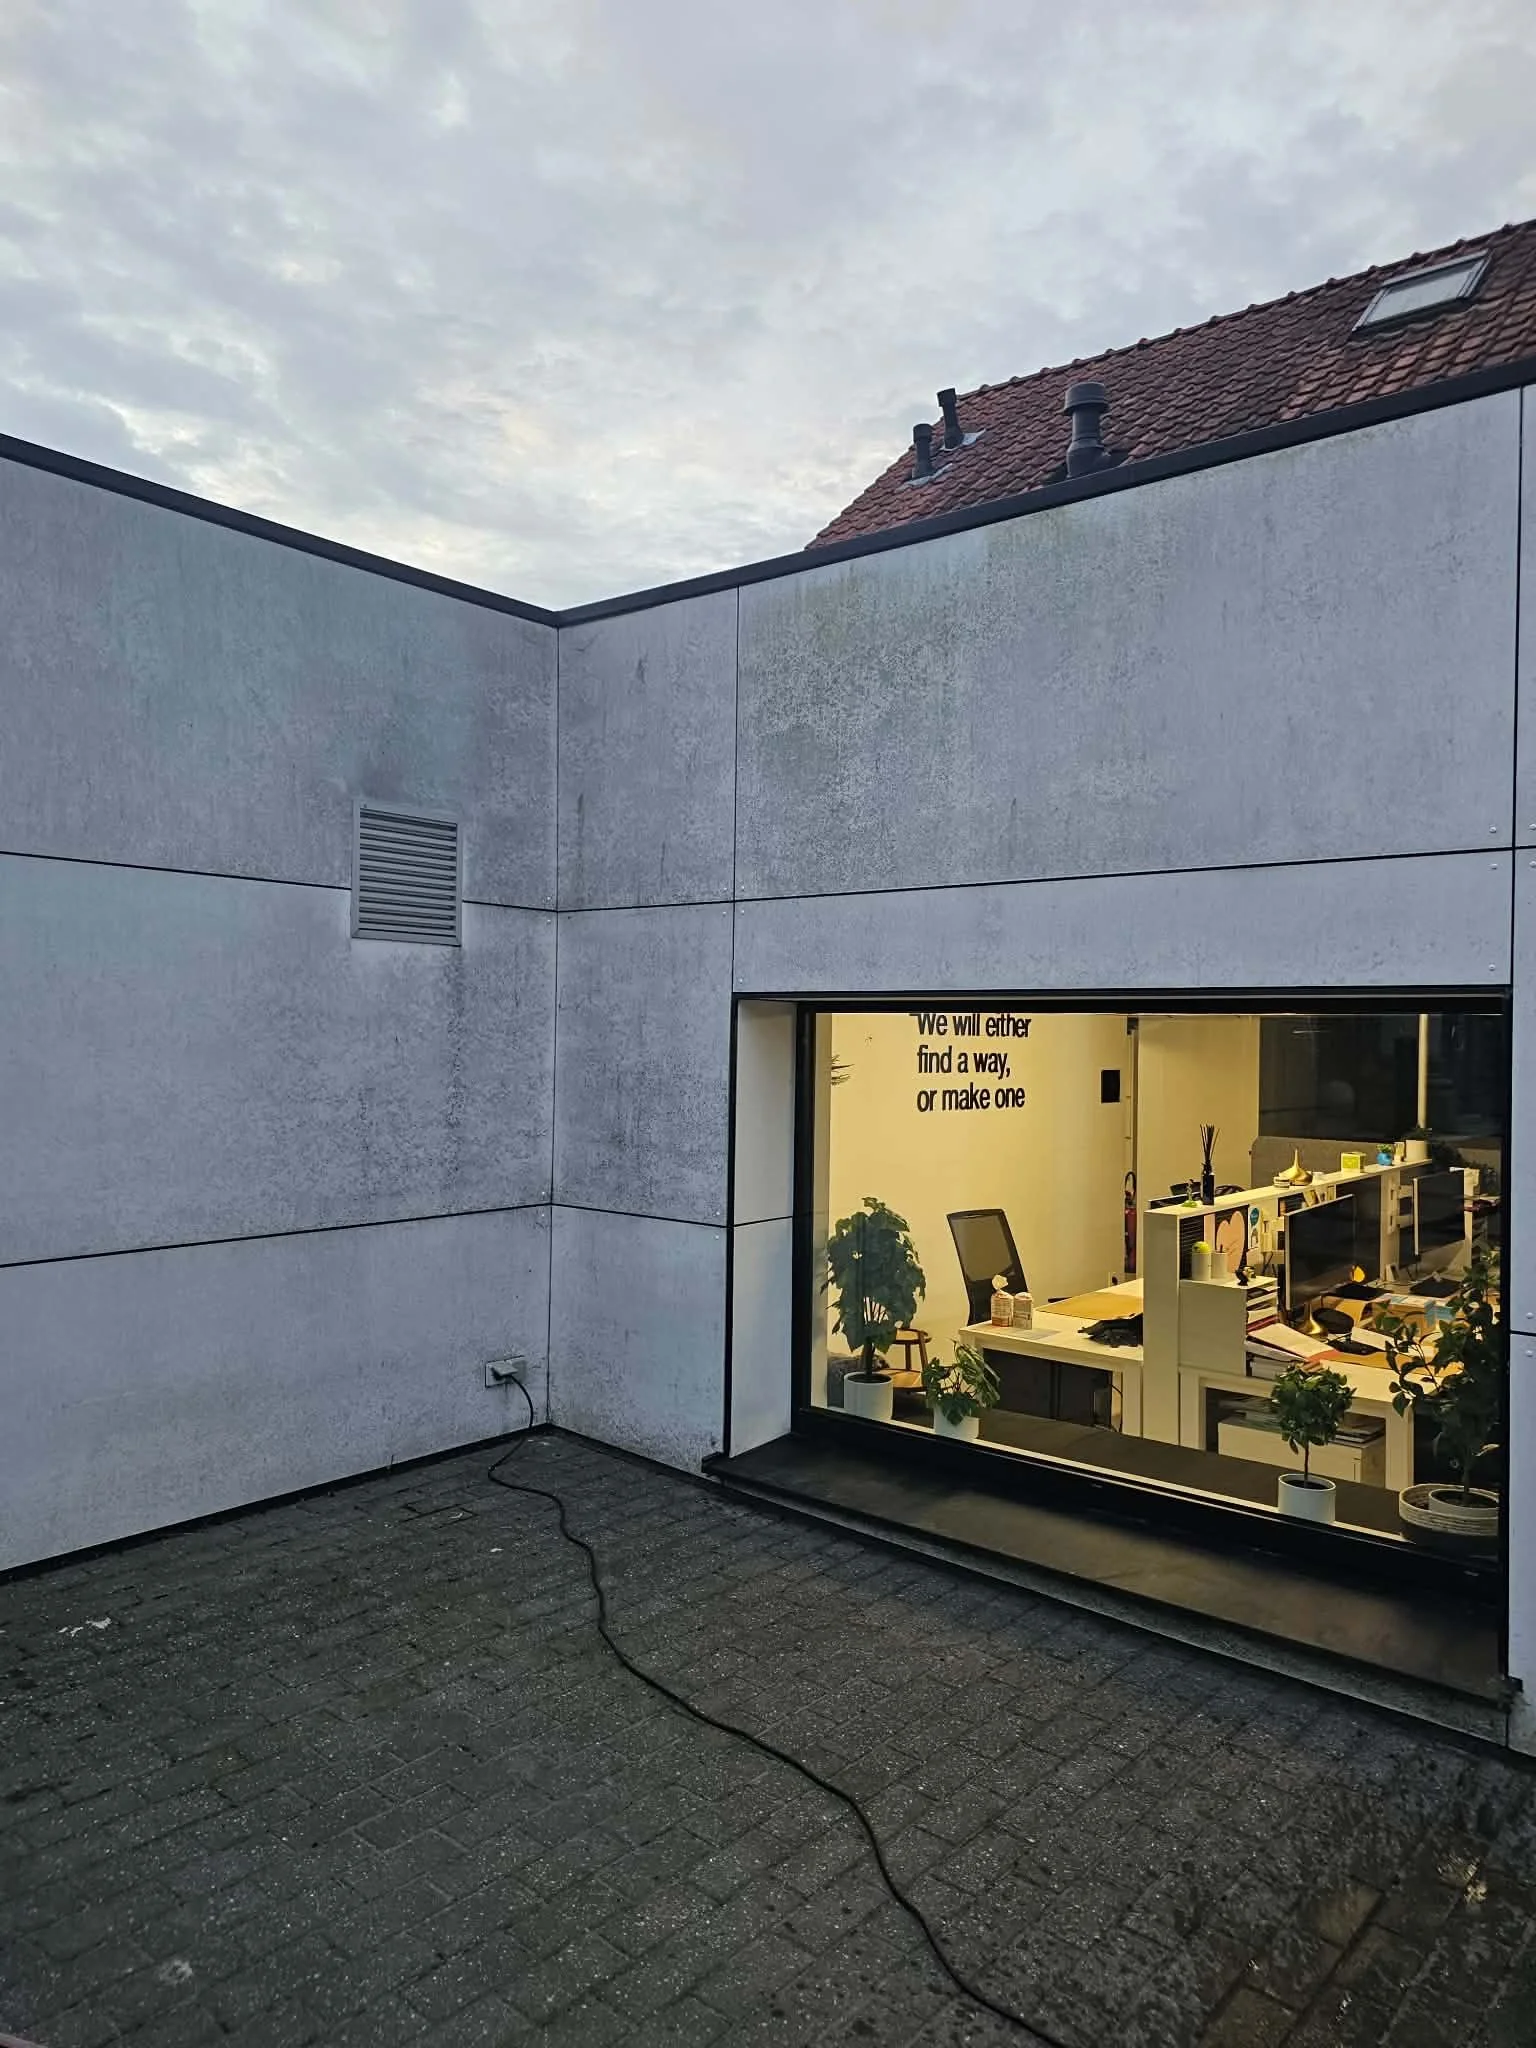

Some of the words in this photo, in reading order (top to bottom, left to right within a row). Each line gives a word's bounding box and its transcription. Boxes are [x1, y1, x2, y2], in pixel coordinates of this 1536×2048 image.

[917, 1013, 948, 1036] We
[953, 1014, 981, 1037] will
[985, 1013, 1032, 1038] either
[917, 1045, 952, 1074] find
[957, 1052, 969, 1074] a
[973, 1052, 1011, 1080] way,
[917, 1089, 937, 1113] or
[941, 1082, 991, 1111] make
[994, 1087, 1026, 1109] one
